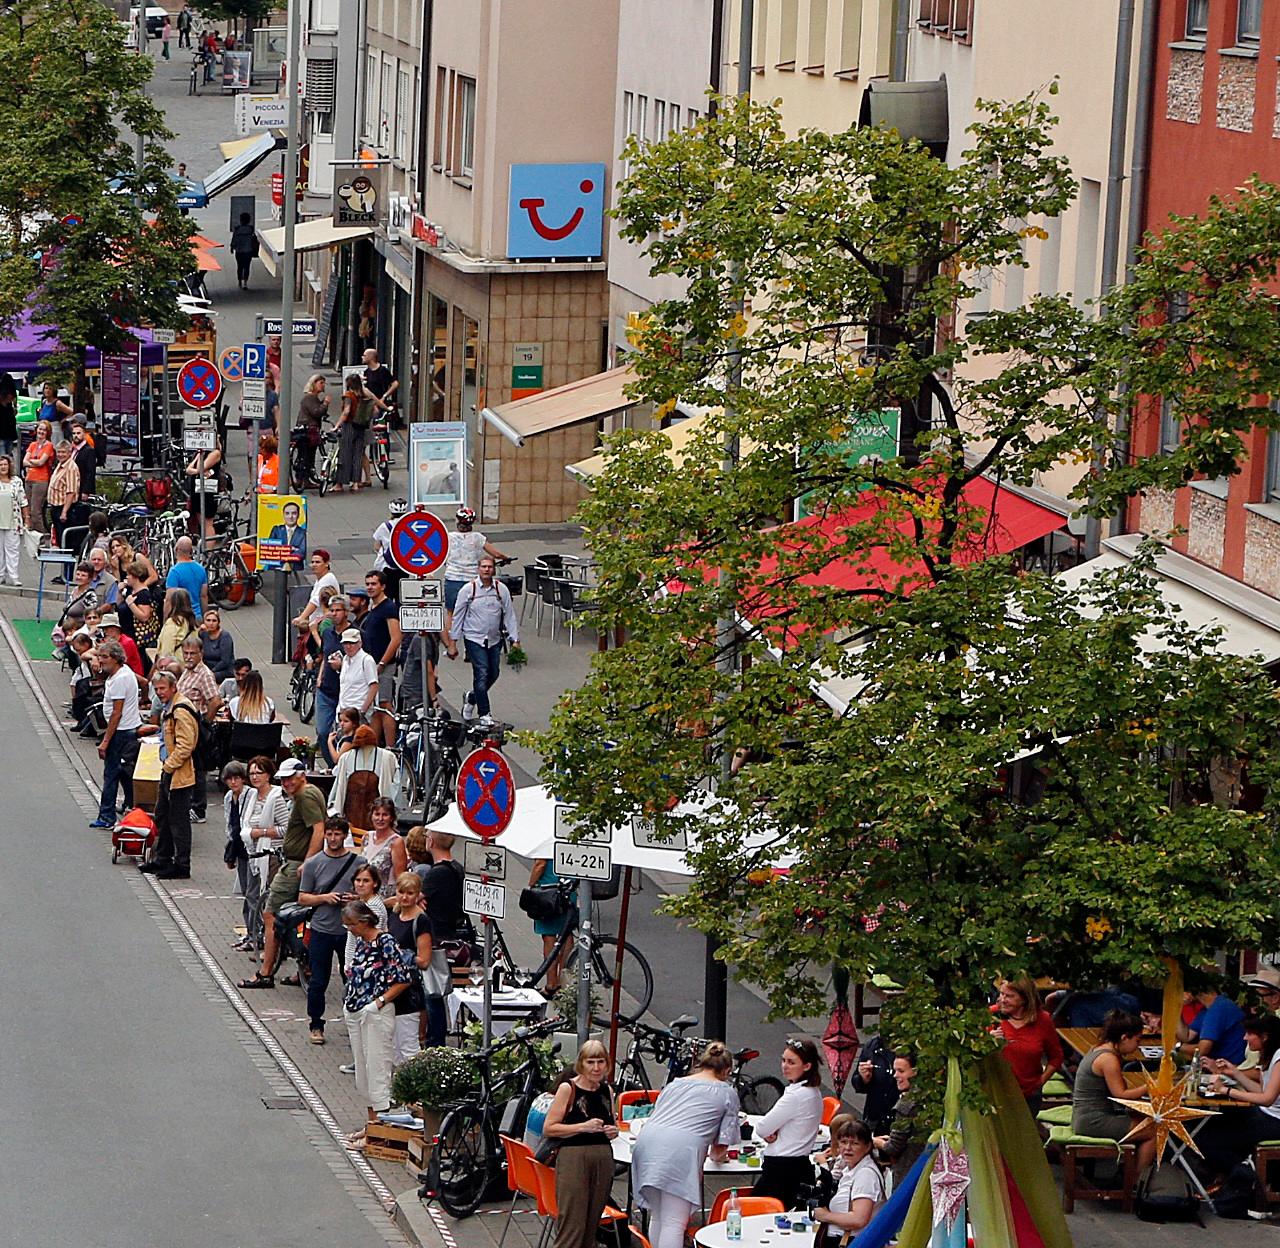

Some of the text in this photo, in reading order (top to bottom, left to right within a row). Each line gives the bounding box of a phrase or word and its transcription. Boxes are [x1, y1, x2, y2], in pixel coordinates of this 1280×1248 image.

[253, 116, 285, 126] VENEZIA
[340, 212, 375, 222] BLECK
[523, 353, 533, 361] 19
[560, 853, 605, 869] 14-22h
